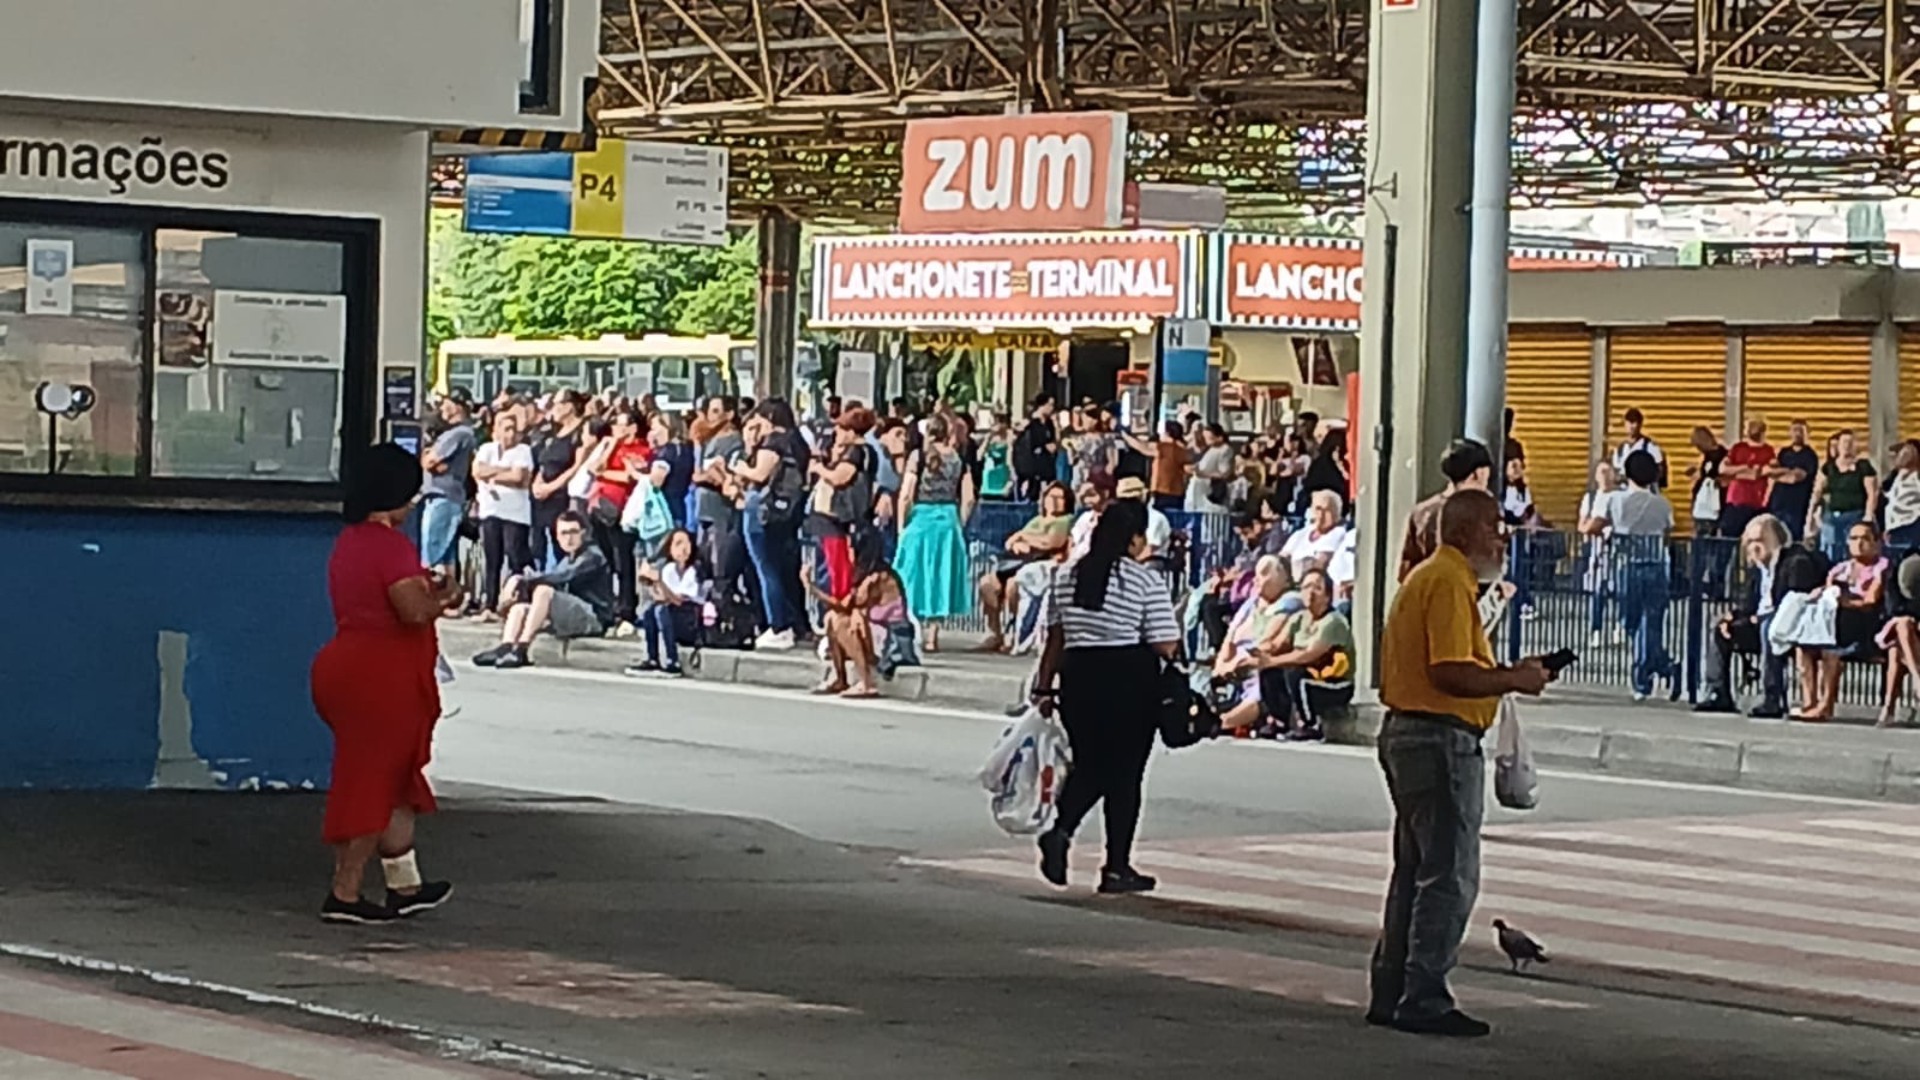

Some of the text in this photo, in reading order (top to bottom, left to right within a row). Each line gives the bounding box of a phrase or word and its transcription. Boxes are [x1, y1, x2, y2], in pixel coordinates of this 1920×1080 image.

[0, 136, 228, 194] rmações
[922, 132, 1093, 212] zum
[579, 173, 616, 202] P4
[832, 258, 1174, 299] LANCHONETE TERMINAL
[997, 333, 1053, 348] CAIXA
[1168, 327, 1183, 347] N
